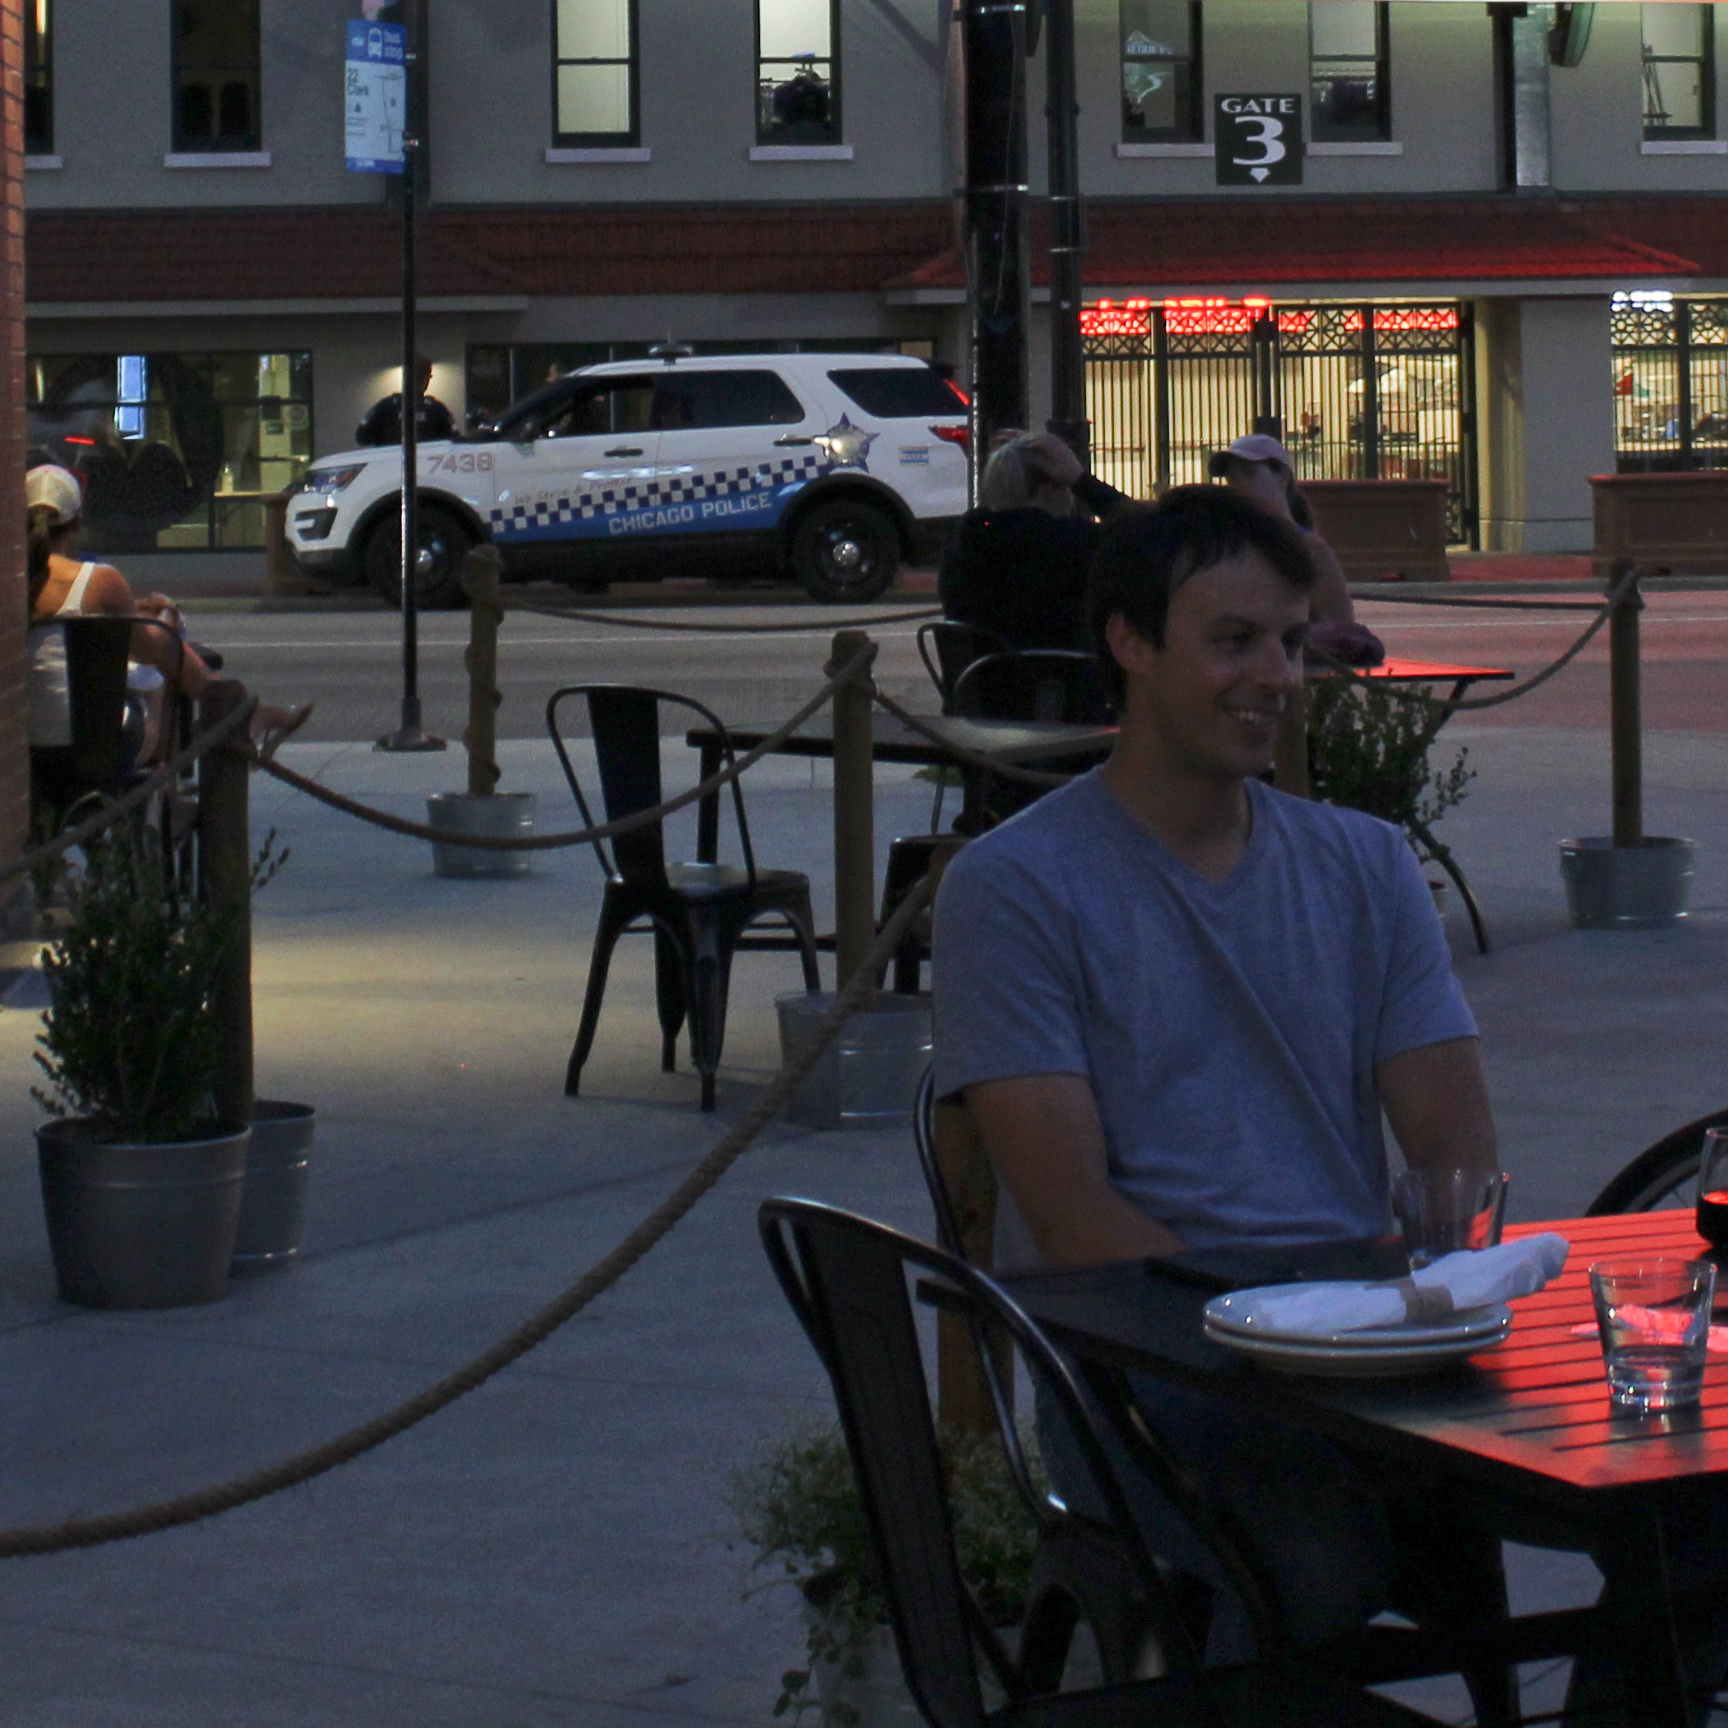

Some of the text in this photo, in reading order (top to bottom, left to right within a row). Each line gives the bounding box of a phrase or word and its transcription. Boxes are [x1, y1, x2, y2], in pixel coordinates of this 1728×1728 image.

[1221, 97, 1296, 114] GATE
[1232, 115, 1286, 166] 3
[427, 452, 493, 473] 7438
[608, 491, 772, 535] CHICAGO POLICE
